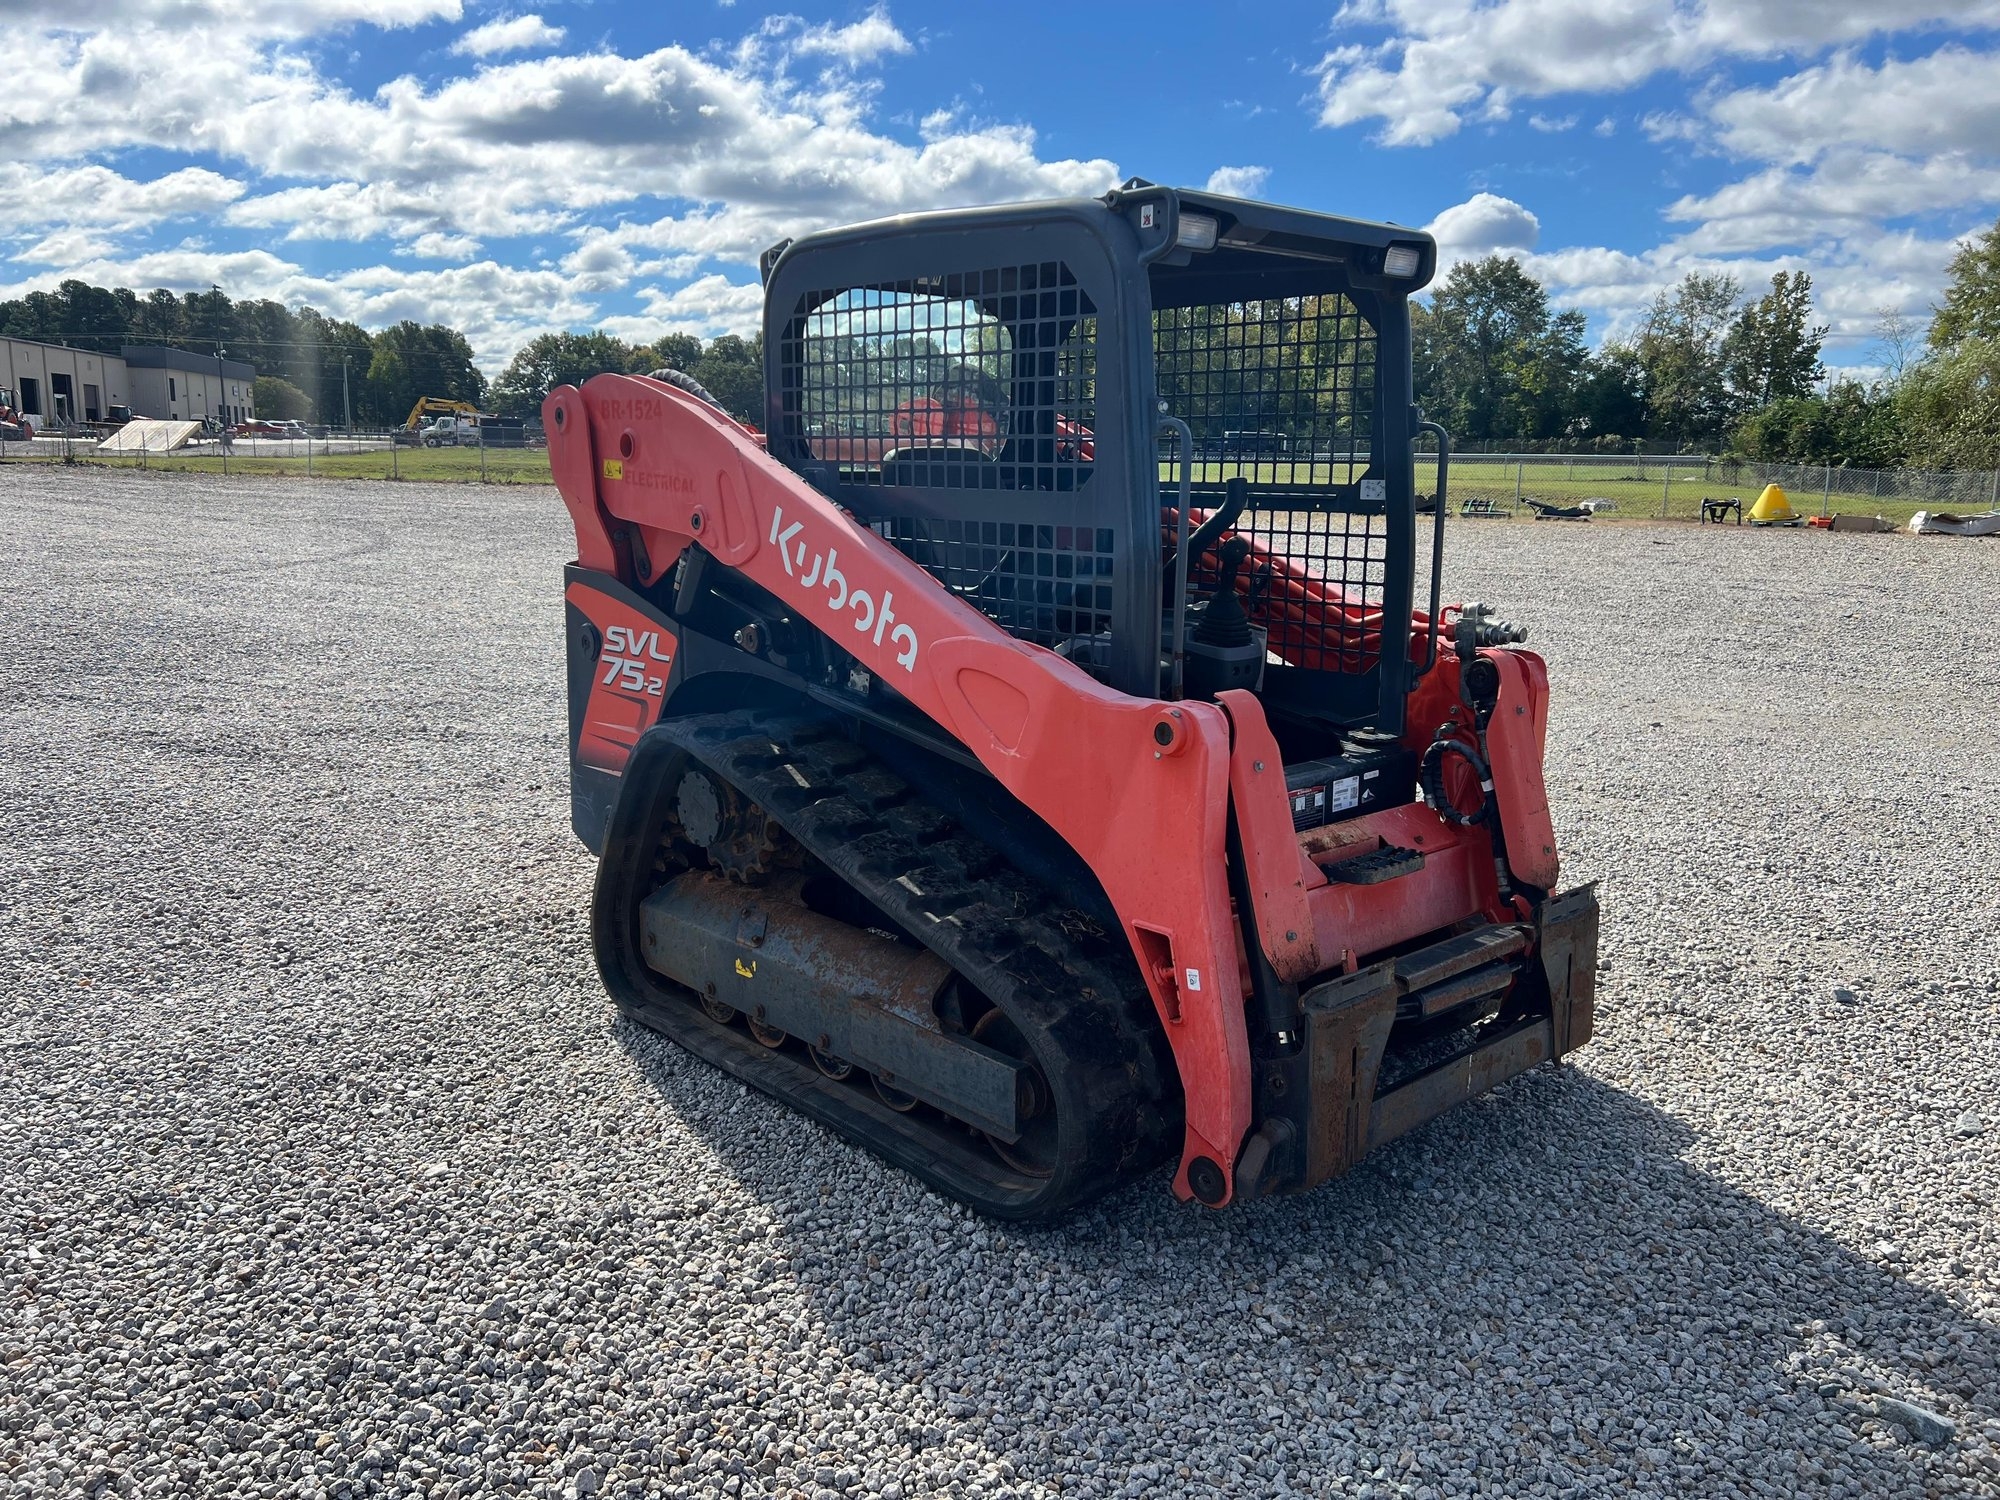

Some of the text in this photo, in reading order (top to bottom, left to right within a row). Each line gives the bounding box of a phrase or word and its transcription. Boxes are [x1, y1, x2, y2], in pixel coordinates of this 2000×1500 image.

[625, 470, 696, 493] ELECTRICAL
[769, 505, 918, 673] Kubota
[604, 625, 670, 662] SVL
[601, 655, 662, 696] 75-2
